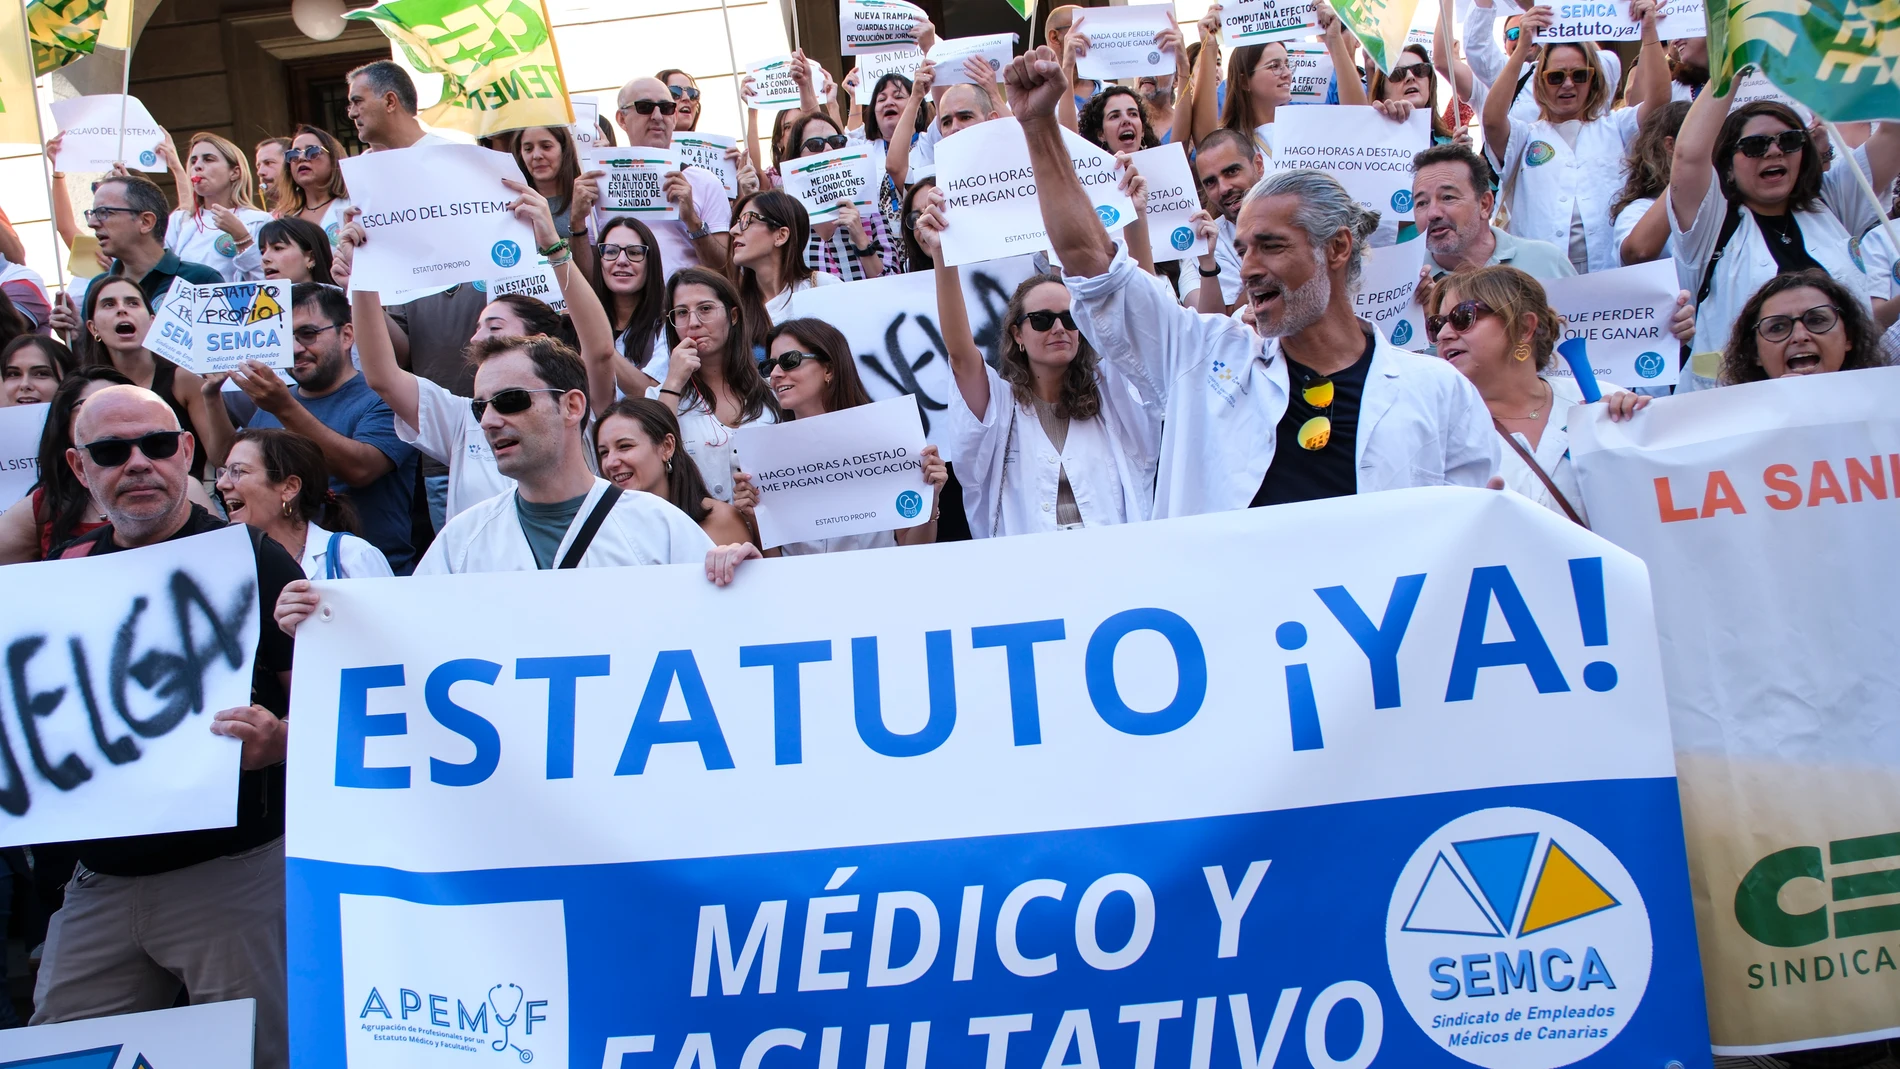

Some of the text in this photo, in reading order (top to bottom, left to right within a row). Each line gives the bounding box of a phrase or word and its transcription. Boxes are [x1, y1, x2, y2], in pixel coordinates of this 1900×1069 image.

[1263, 1, 1275, 10] NO
[1560, 4, 1617, 19] SEMCA
[1677, 4, 1699, 14] HAY
[854, 12, 880, 20] NUEVA
[1226, 4, 1317, 27] COMPUTAN A EFECTOS
[1242, 15, 1302, 33] DE JUBILACIÓN
[1536, 21, 1612, 38] Estatuto
[846, 32, 884, 42] DEVOLUCIÓN
[875, 53, 892, 63] SIN
[766, 71, 791, 81] MEJORA
[868, 70, 884, 79] NO
[890, 65, 906, 75] HAY
[757, 82, 769, 90] LAS
[1298, 76, 1328, 85] EFECTOS
[766, 86, 799, 96] LABORALE
[101, 127, 118, 136] DEL
[119, 128, 157, 136] ISTEMA
[705, 150, 718, 160] LAS
[1284, 146, 1411, 158] HAGO HORAS A DESTAJO
[1071, 156, 1102, 170] TAJO
[1274, 160, 1413, 172] Y ME PAGAN CON VOCACIÓ
[611, 172, 658, 181] NO AL NUEVO
[810, 172, 841, 187] MEJORA
[842, 169, 853, 179] DE
[948, 166, 1034, 192] HAGO HORAS
[1078, 171, 1117, 187] ACIÓN
[608, 181, 660, 190] ESTATUTO DEL
[608, 190, 661, 198] MINISTERIO DE
[802, 188, 817, 199] LAS
[814, 187, 858, 205] LABORALES
[949, 184, 1037, 209] ME PAGAN CO
[1147, 186, 1183, 202] ESTAJO
[618, 199, 651, 207] SANIDAD
[1145, 198, 1195, 215] OCACIÓN
[362, 208, 417, 229] ESCLAVO
[418, 205, 447, 220] DEL
[1004, 231, 1042, 243] ESTATUTO
[412, 259, 471, 275] ESTATUTO PROPIO
[493, 284, 505, 295] UN
[505, 274, 546, 292] ESTATUTO
[526, 283, 550, 297] PARA
[1368, 281, 1413, 304] PERDER
[1375, 298, 1411, 321] GANA
[1592, 307, 1655, 322] PERDER
[160, 320, 194, 350] SEM
[206, 328, 281, 351] SEMCA
[1564, 326, 1659, 341] QUE GANAR
[206, 350, 280, 363] Sindicato de Empleados
[1545, 368, 1612, 377] ESTATU OPIO
[8, 457, 38, 471] SIST
[758, 447, 907, 482] HAGO HORAS A DESTAJO
[762, 459, 922, 493] ME PAGAN CON VOCACIÓN
[1653, 470, 1747, 523] LA
[815, 511, 877, 526] ESTATUTO PROPIO
[333, 556, 1620, 790] ESTATUTO ¡YA!
[690, 859, 1272, 998] MÉDICO Y
[1428, 946, 1617, 1001] SEMCA
[1747, 946, 1897, 989] SINDICA
[1431, 1004, 1616, 1029] Sindicato de Empleados
[361, 1022, 407, 1034] Agrupación
[408, 1025, 418, 1033] de
[418, 1027, 463, 1041] Profesionales
[463, 1035, 476, 1044] por
[1448, 1024, 1609, 1048] Médicos de Canarias
[374, 1034, 408, 1042] Estatuto
[408, 1034, 435, 1046] Médico
[440, 1040, 477, 1053] Facultativo
